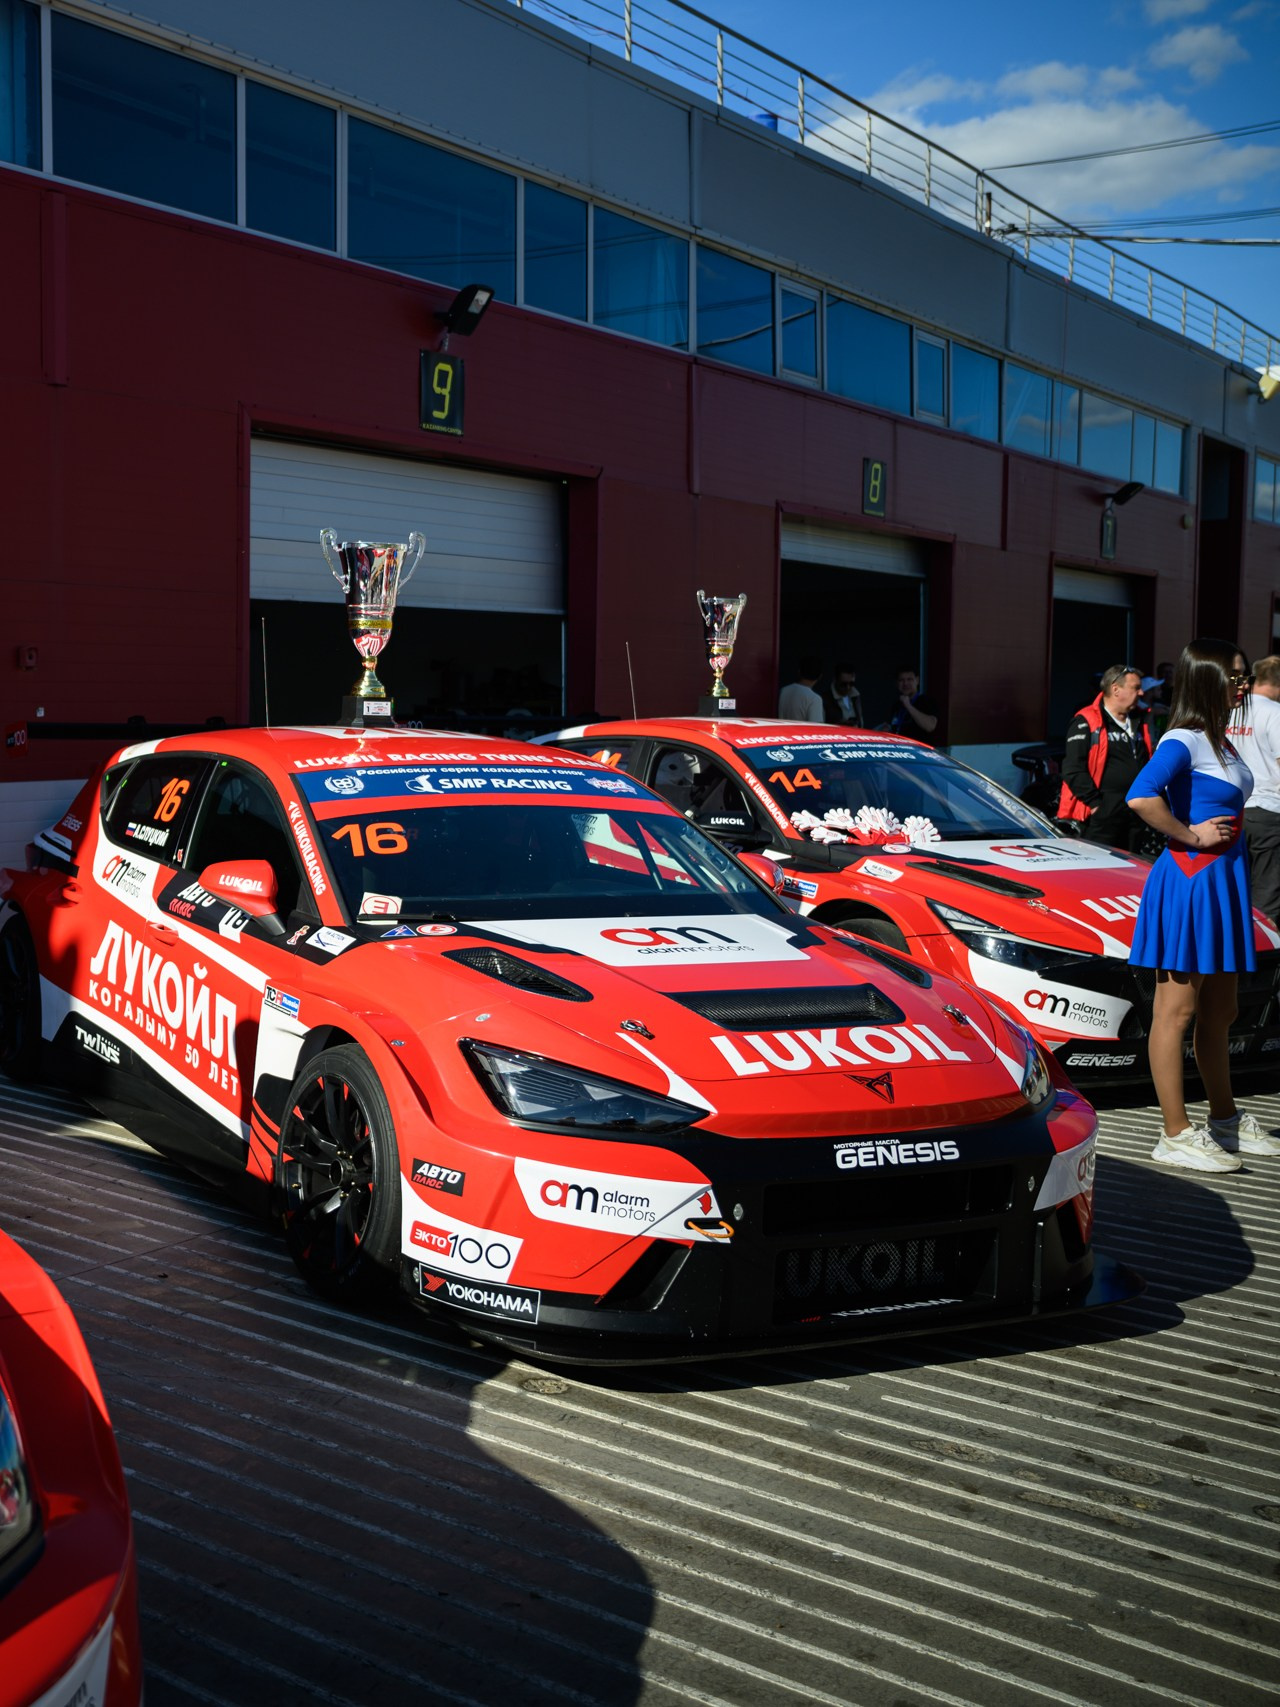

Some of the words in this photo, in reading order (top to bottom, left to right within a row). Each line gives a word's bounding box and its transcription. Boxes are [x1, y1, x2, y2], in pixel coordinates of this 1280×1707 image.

[432, 362, 453, 419] 9
[869, 462, 881, 504] 8
[293, 754, 384, 769] LUKOIL
[386, 753, 478, 762] RACING
[480, 753, 554, 763] TWINS
[838, 750, 868, 758] SMP
[869, 751, 916, 760] RACING
[356, 766, 437, 777] Российская
[439, 766, 479, 774] серия
[482, 767, 550, 775] кольцевых
[768, 768, 822, 793] 14
[438, 778, 488, 789] SMP
[490, 778, 573, 791] RACING
[153, 778, 190, 822] 16
[753, 782, 789, 830] LUKOILRACING
[710, 817, 745, 826] LUKOIL
[331, 822, 409, 857] 16
[293, 819, 327, 896] LUKOILRACING
[126, 865, 147, 884] alarm
[219, 874, 263, 892] LUKOIL
[600, 926, 740, 947] am
[90, 919, 238, 1071] ЛУКОЙЛ
[1023, 989, 1071, 1017] am
[1068, 1011, 1109, 1029] motors
[1072, 1002, 1107, 1018] alarm
[88, 979, 177, 1051] КОГАЛЫМУ
[185, 1043, 200, 1069] 50
[208, 1061, 238, 1097] ЛЕТ
[709, 1024, 971, 1078] LUKOIL
[1066, 1054, 1137, 1067] GENESIS
[833, 1140, 874, 1150] МОТОРНЫЕ
[835, 1140, 960, 1170] GENESIS
[412, 1174, 444, 1190] ПЛЮС
[416, 1162, 462, 1185] АВТО
[540, 1178, 599, 1214] am
[602, 1189, 651, 1208] alarm
[600, 1203, 657, 1224] motors
[414, 1228, 448, 1249] ЭКТО
[446, 1233, 512, 1270] 100
[776, 1239, 945, 1297] UKOIL
[445, 1281, 533, 1314] YOKOHAMA
